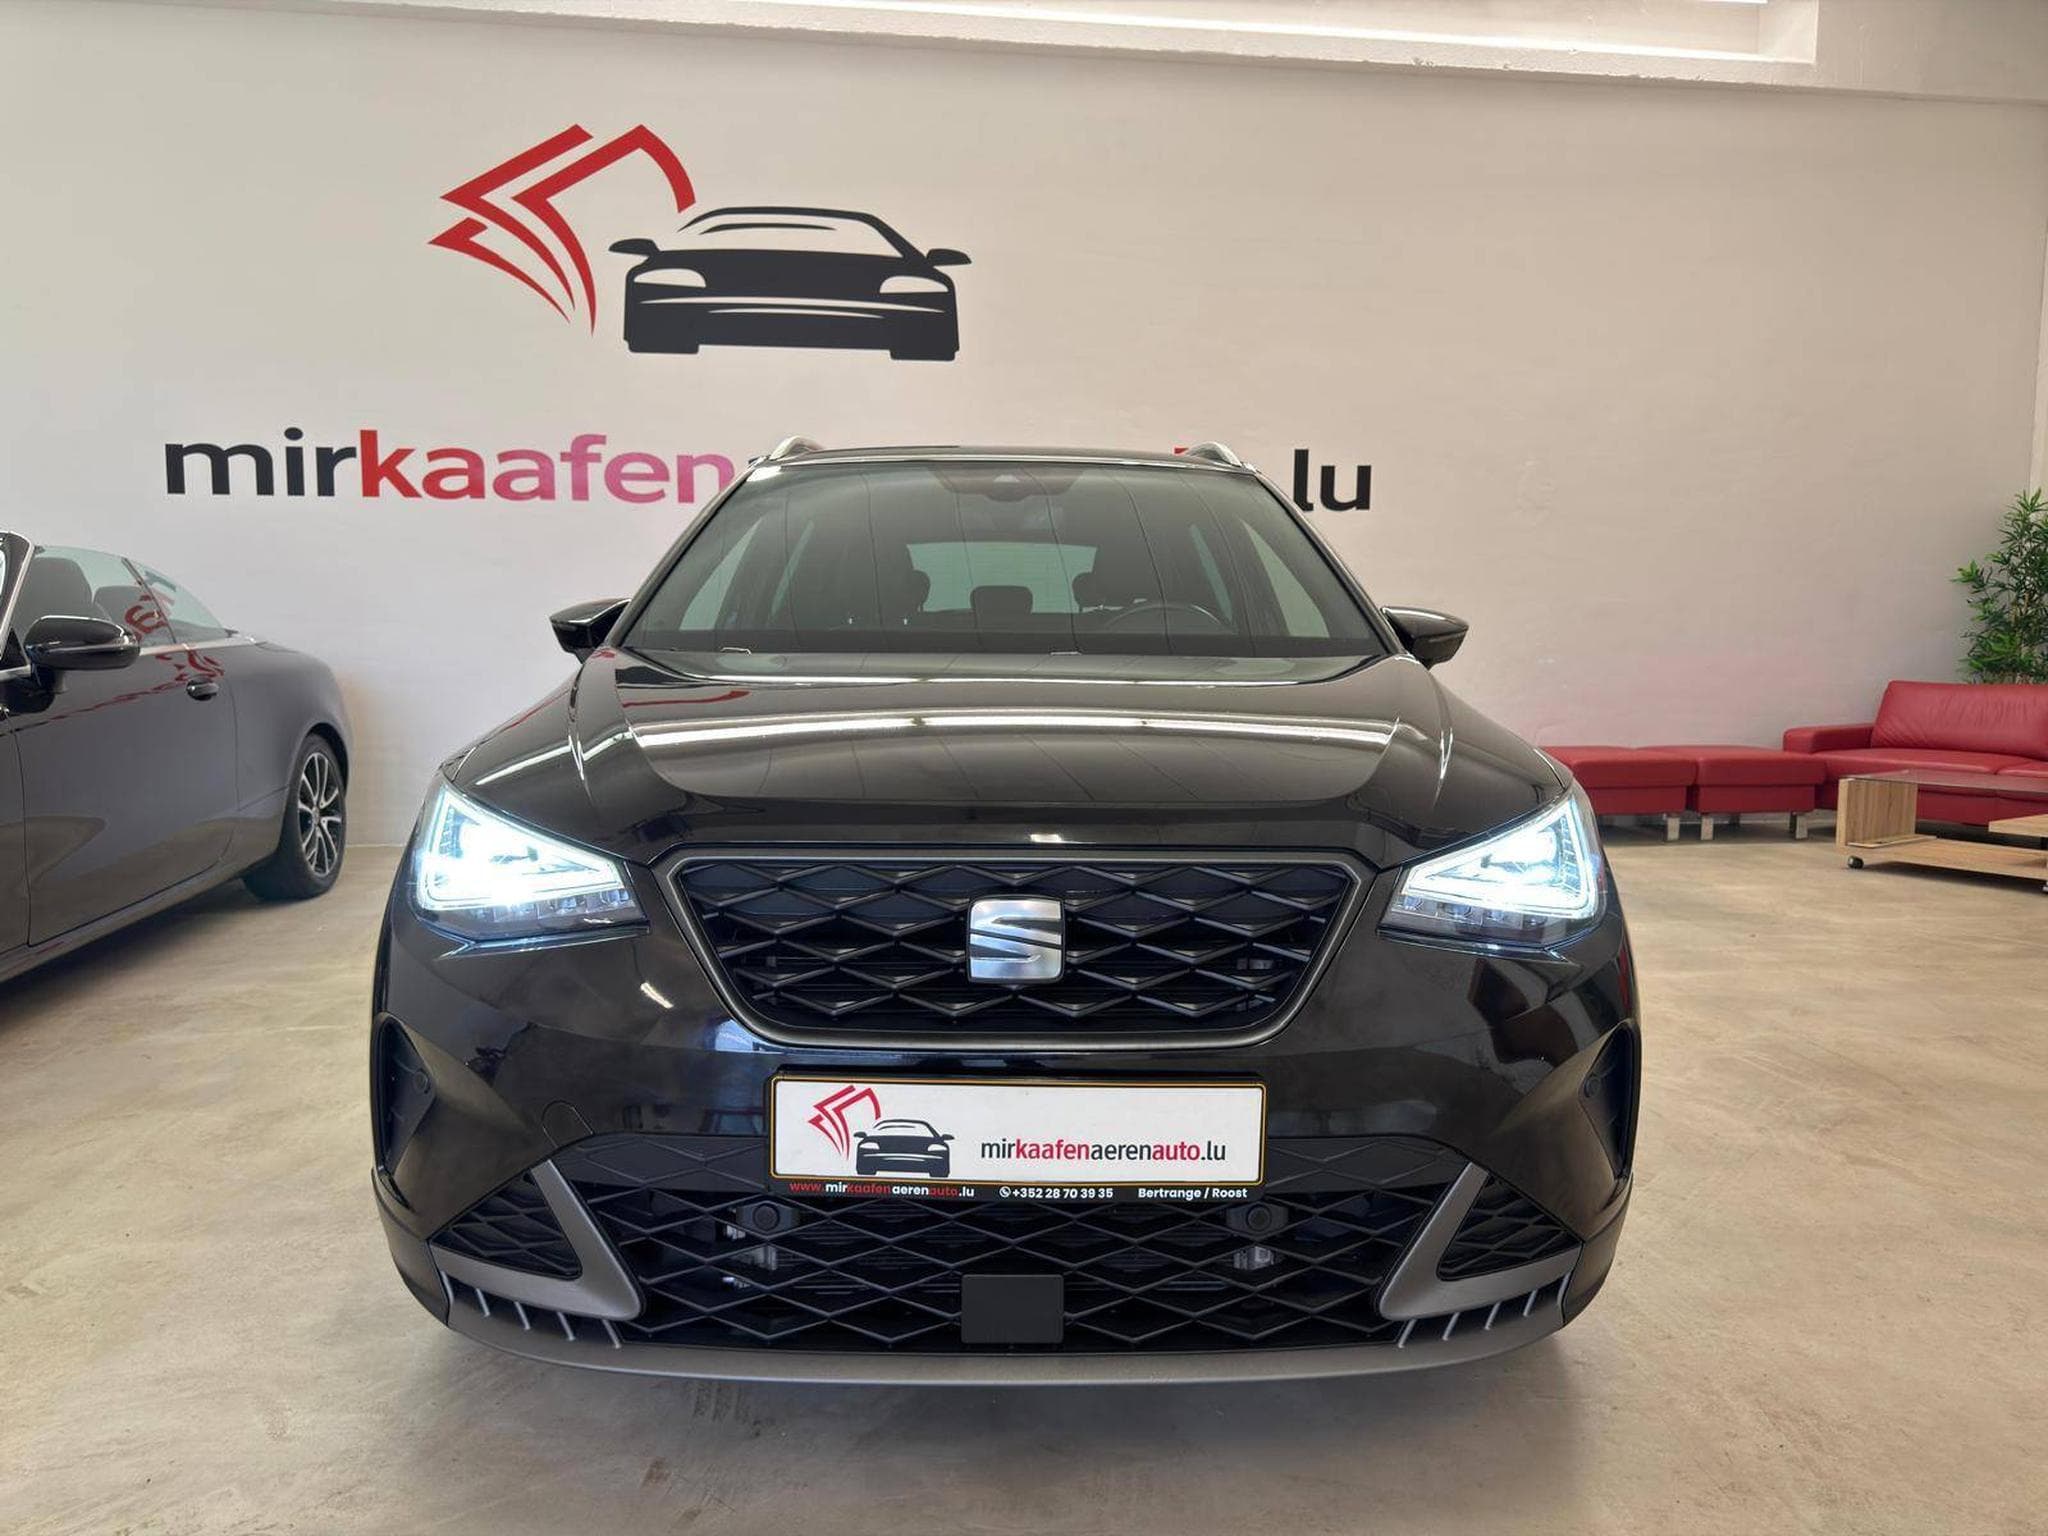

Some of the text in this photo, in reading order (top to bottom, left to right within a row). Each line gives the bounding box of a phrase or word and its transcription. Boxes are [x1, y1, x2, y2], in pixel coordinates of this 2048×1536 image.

[980, 1138, 1226, 1161] mirkaafenaerenauto.lu
[1045, 1188, 1060, 1199] 28
[1063, 1188, 1078, 1199] 70
[1080, 1188, 1096, 1199] 39
[1098, 1188, 1113, 1199] 35
[1138, 1188, 1201, 1201] Bertrange
[1212, 1188, 1248, 1199] Roost
